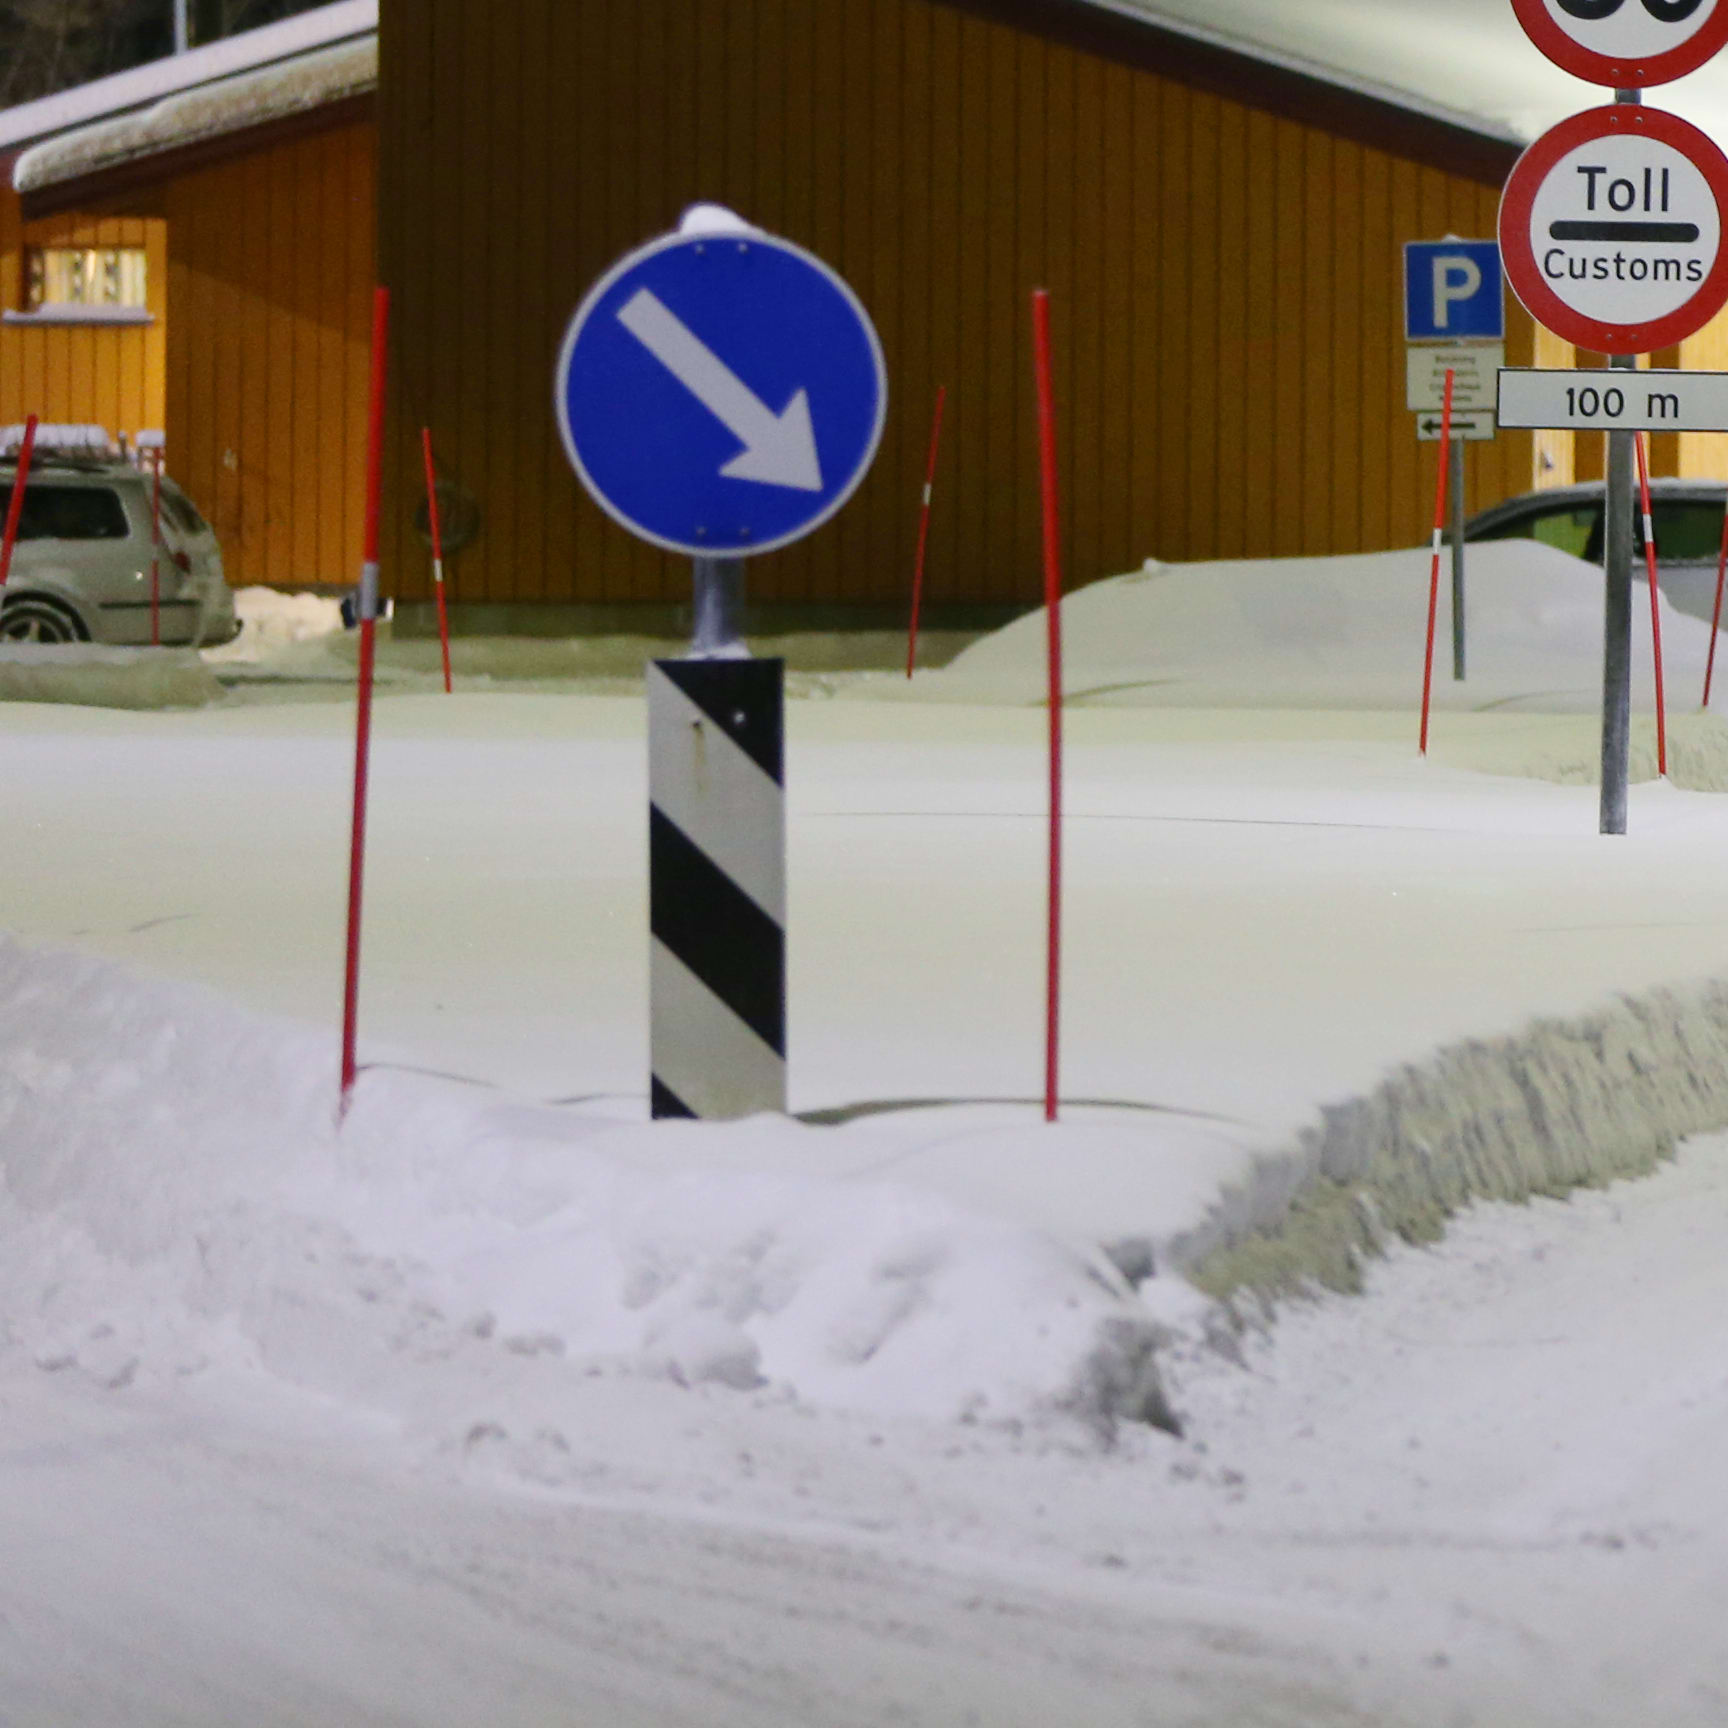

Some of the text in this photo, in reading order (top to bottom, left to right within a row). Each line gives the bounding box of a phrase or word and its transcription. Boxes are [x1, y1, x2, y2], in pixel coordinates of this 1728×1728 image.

[1577, 166, 1669, 212] Toll
[1543, 249, 1703, 282] Customs
[1432, 256, 1482, 328] P
[1566, 387, 1680, 419] 100 m
